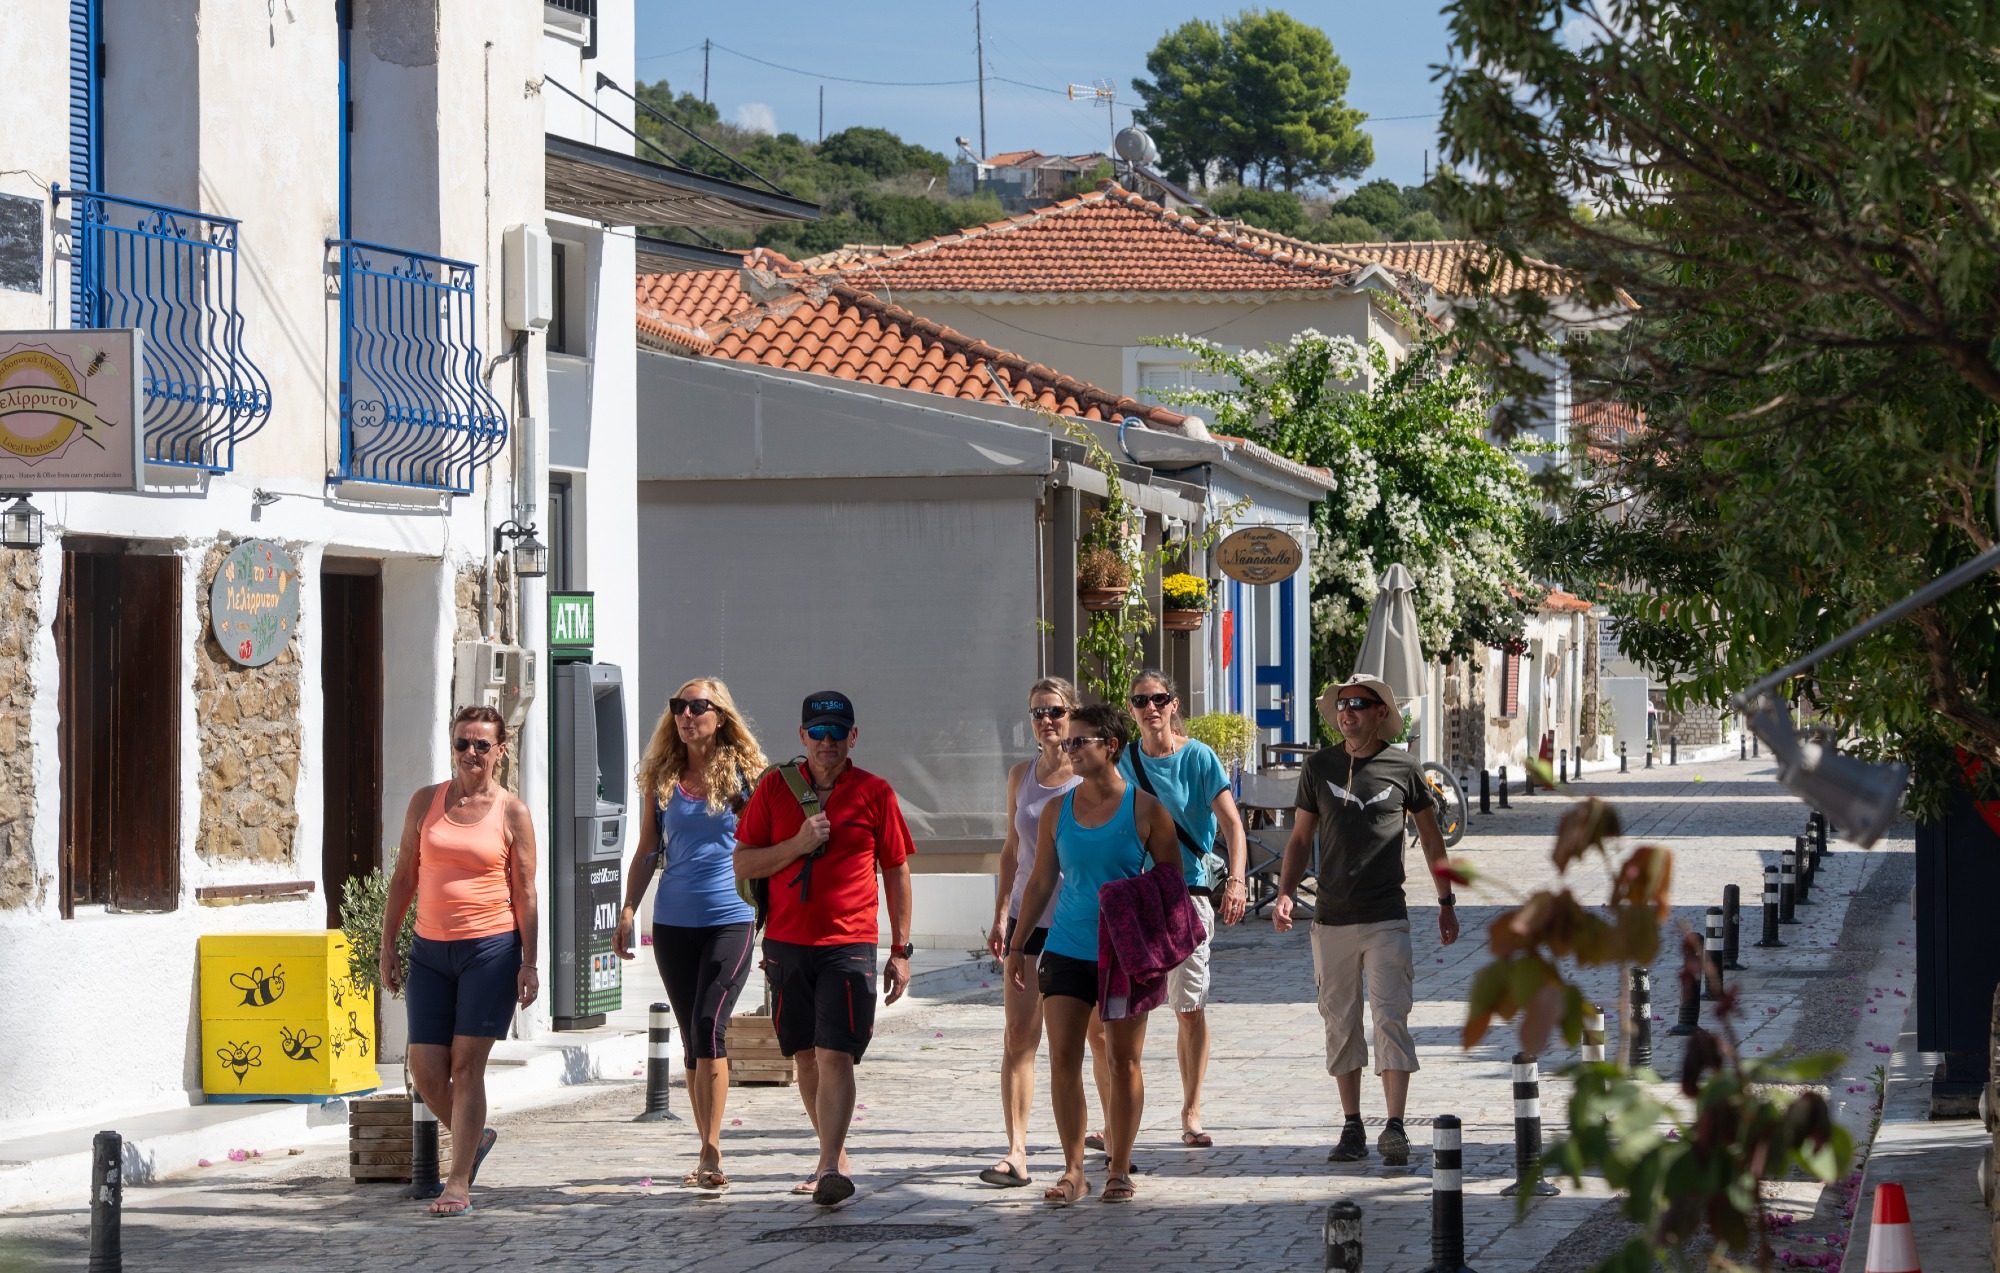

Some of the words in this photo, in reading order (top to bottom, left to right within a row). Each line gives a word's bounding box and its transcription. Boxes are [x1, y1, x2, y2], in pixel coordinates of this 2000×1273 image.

[0, 391, 78, 409] ελίρρυτον
[2, 436, 23, 452] Local
[25, 439, 58, 453] Products
[555, 602, 589, 640] ATM
[594, 902, 617, 931] ATM
